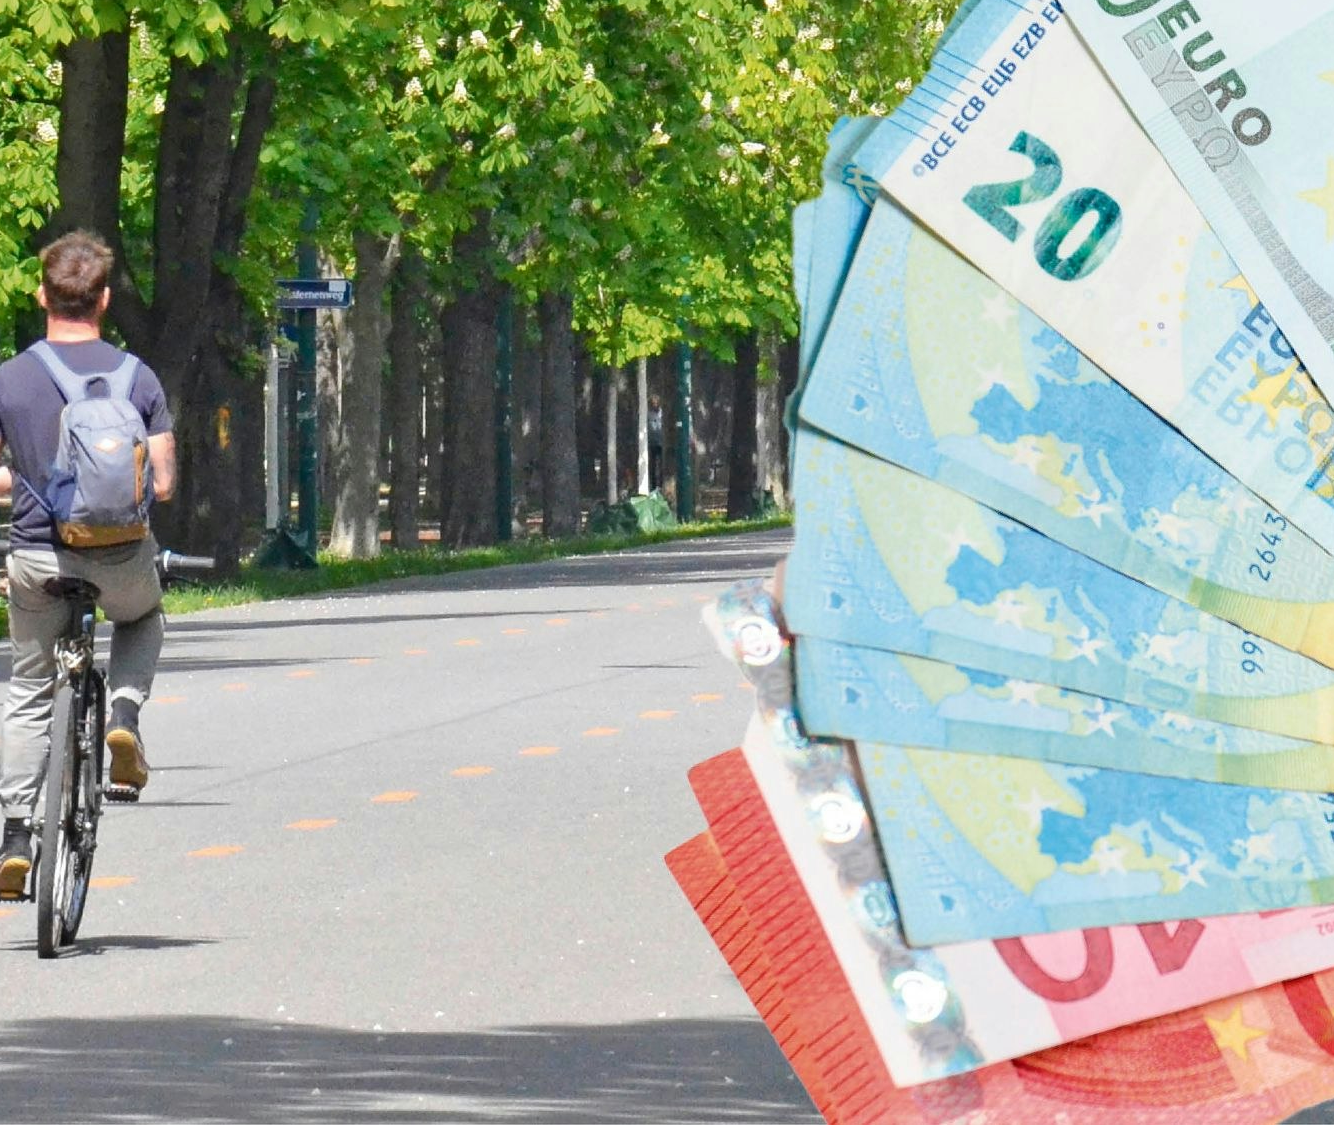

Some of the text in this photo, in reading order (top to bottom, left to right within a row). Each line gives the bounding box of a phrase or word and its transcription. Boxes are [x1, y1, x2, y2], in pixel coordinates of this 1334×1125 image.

[951, 95, 986, 134] ECB
[1011, 22, 1047, 60] EZB
[962, 130, 1124, 281] 20
[1242, 630, 1264, 673] 99
